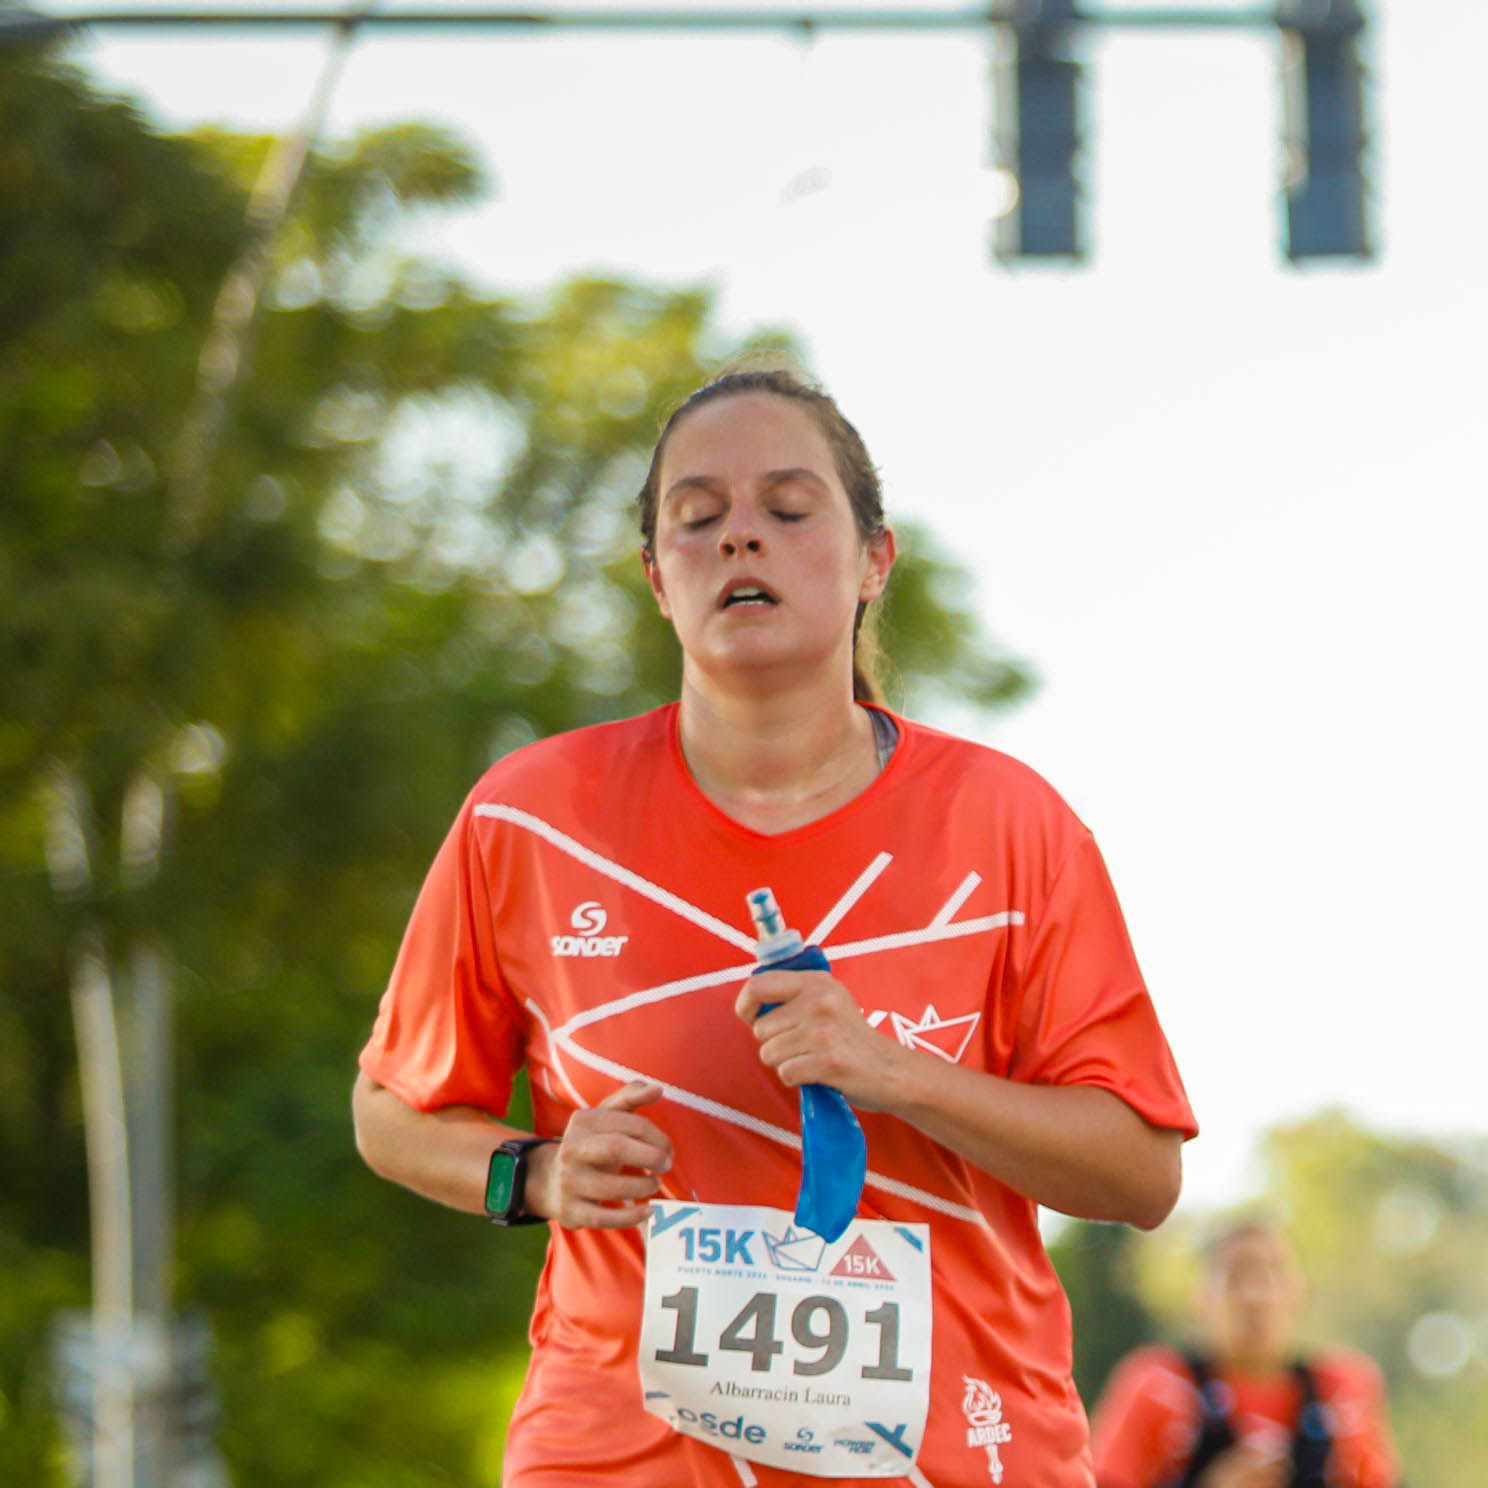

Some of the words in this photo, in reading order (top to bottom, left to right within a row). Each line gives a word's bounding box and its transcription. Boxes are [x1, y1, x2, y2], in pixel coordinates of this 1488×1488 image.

[677, 1227, 756, 1266] 15K
[842, 1255, 881, 1275] 15K
[655, 1286, 914, 1382] 1491
[709, 1381, 799, 1402] Albarracin
[803, 1388, 851, 1406] Laura
[677, 1407, 767, 1444] osde
